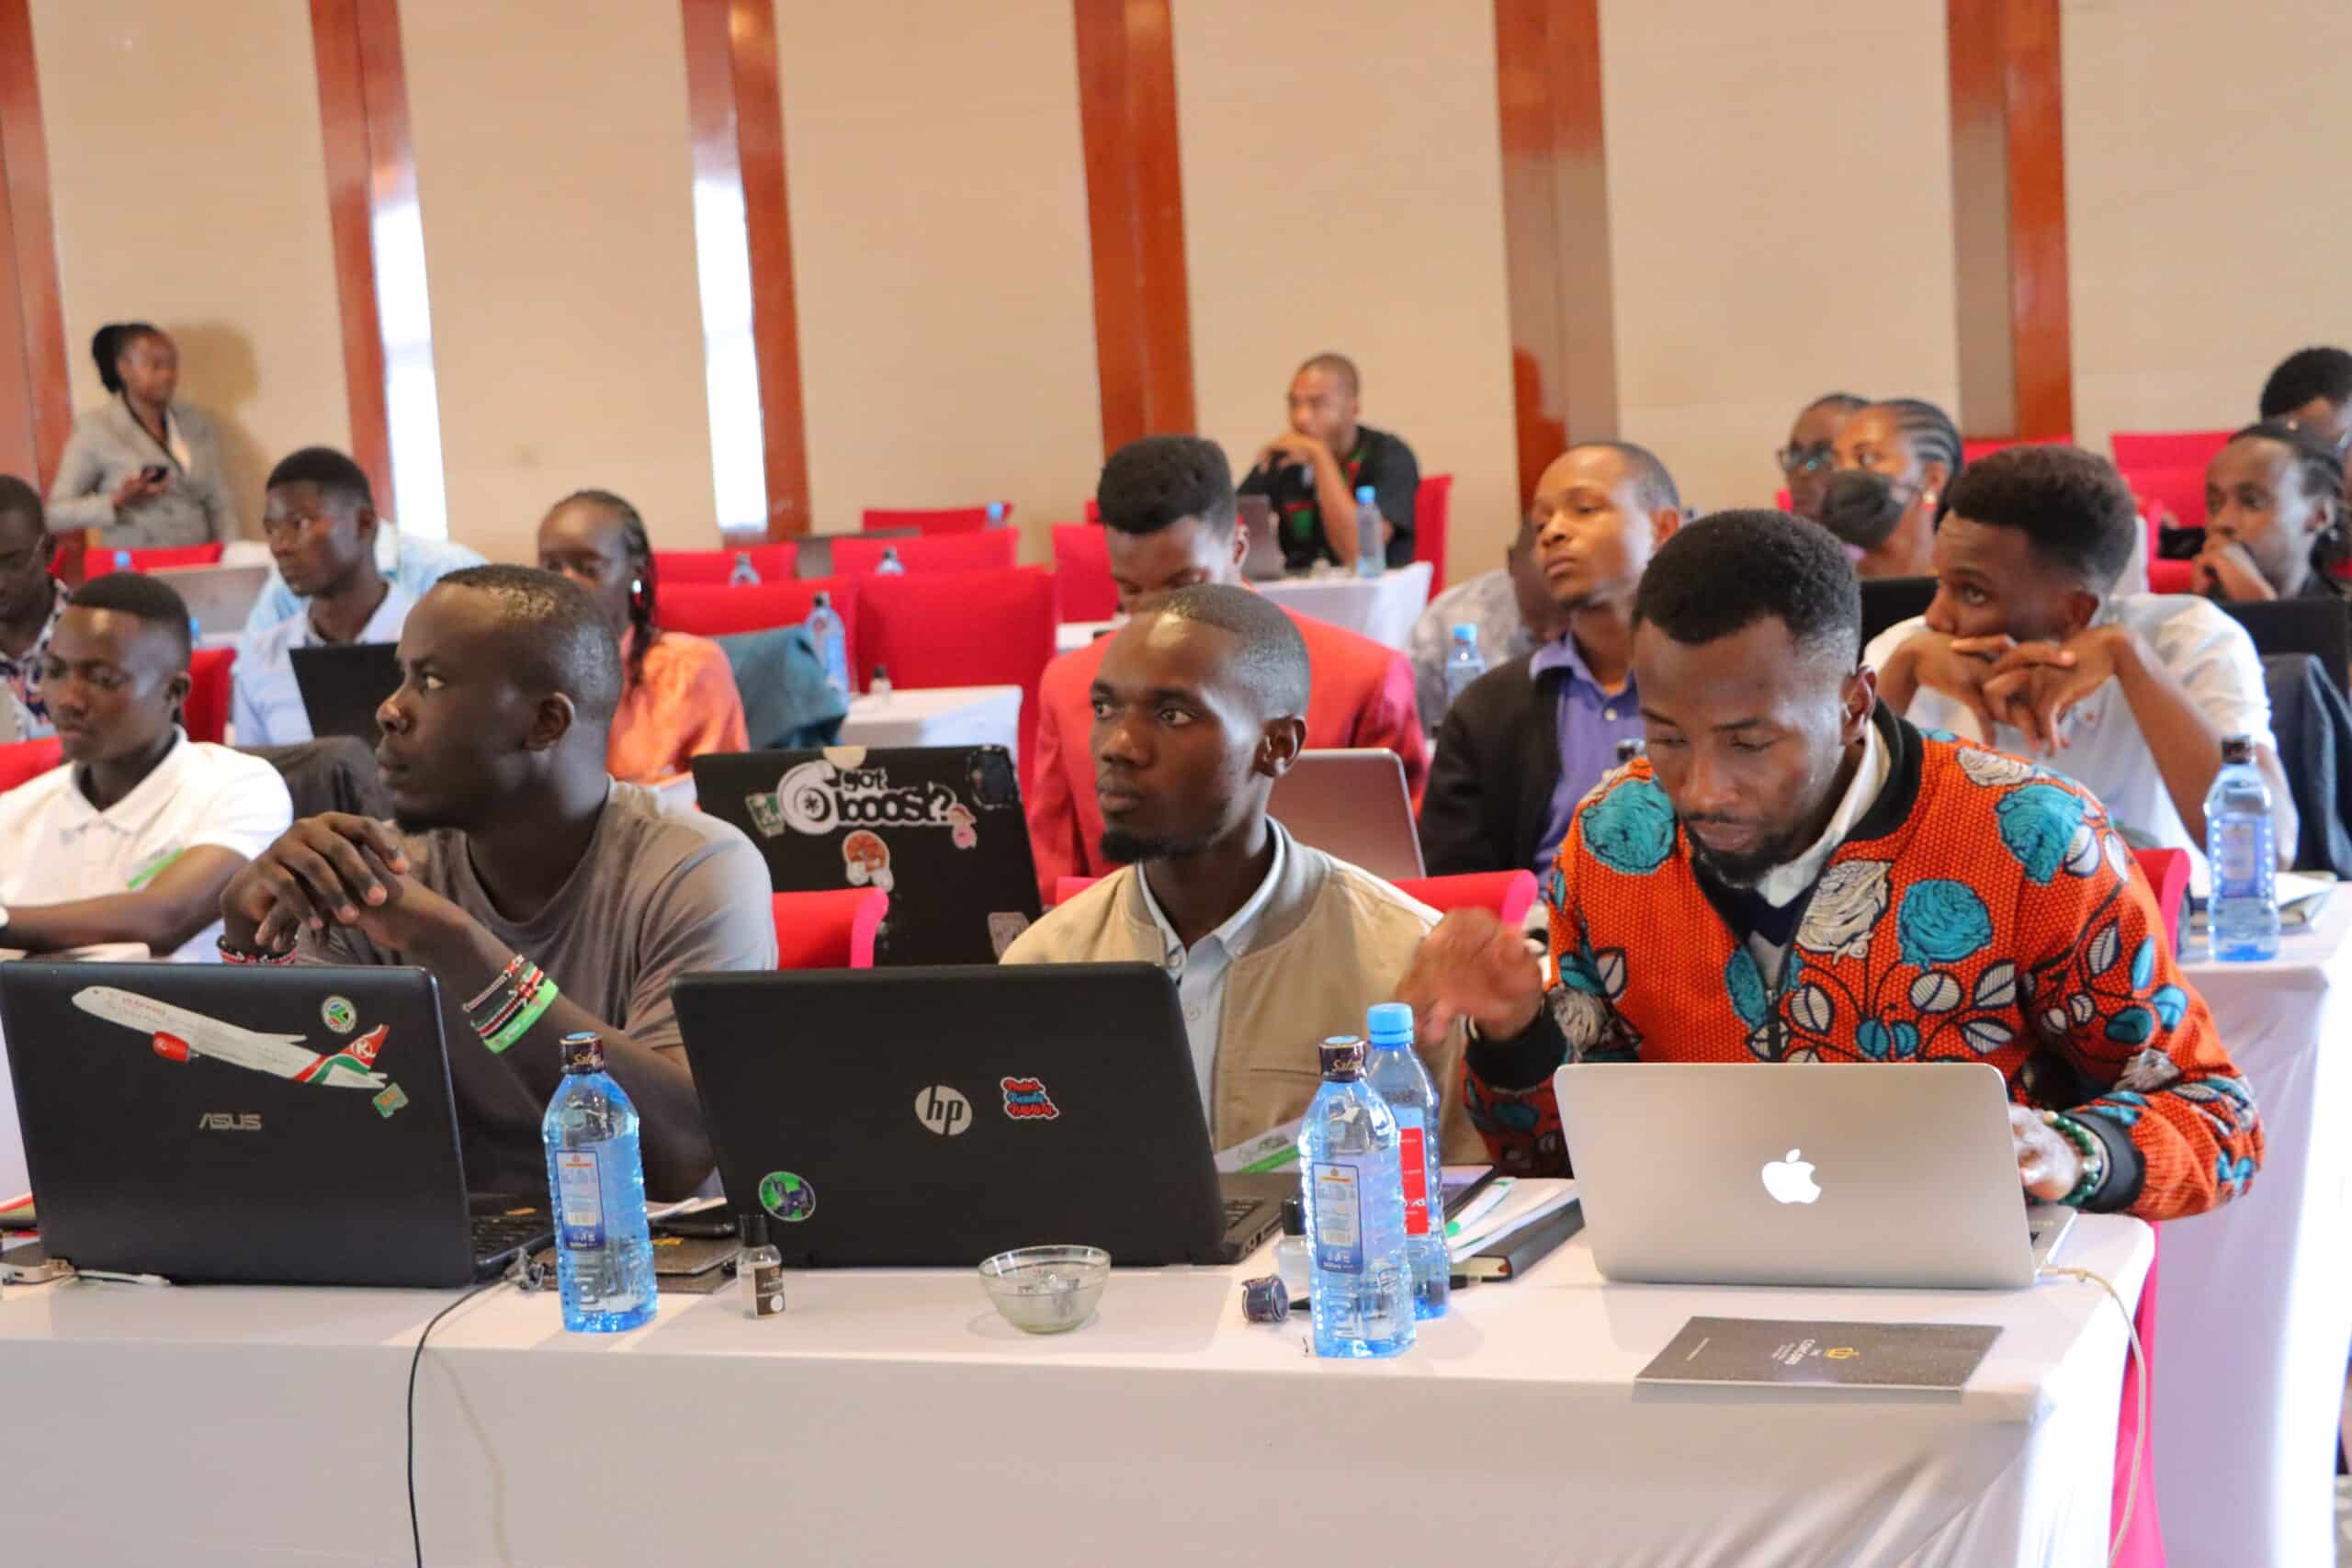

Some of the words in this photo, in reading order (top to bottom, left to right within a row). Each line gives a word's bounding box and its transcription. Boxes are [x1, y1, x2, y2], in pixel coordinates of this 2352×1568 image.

[842, 769, 887, 792] got
[835, 784, 954, 822] boost?
[198, 1112, 263, 1131] ASUS
[925, 1087, 965, 1135] hp
